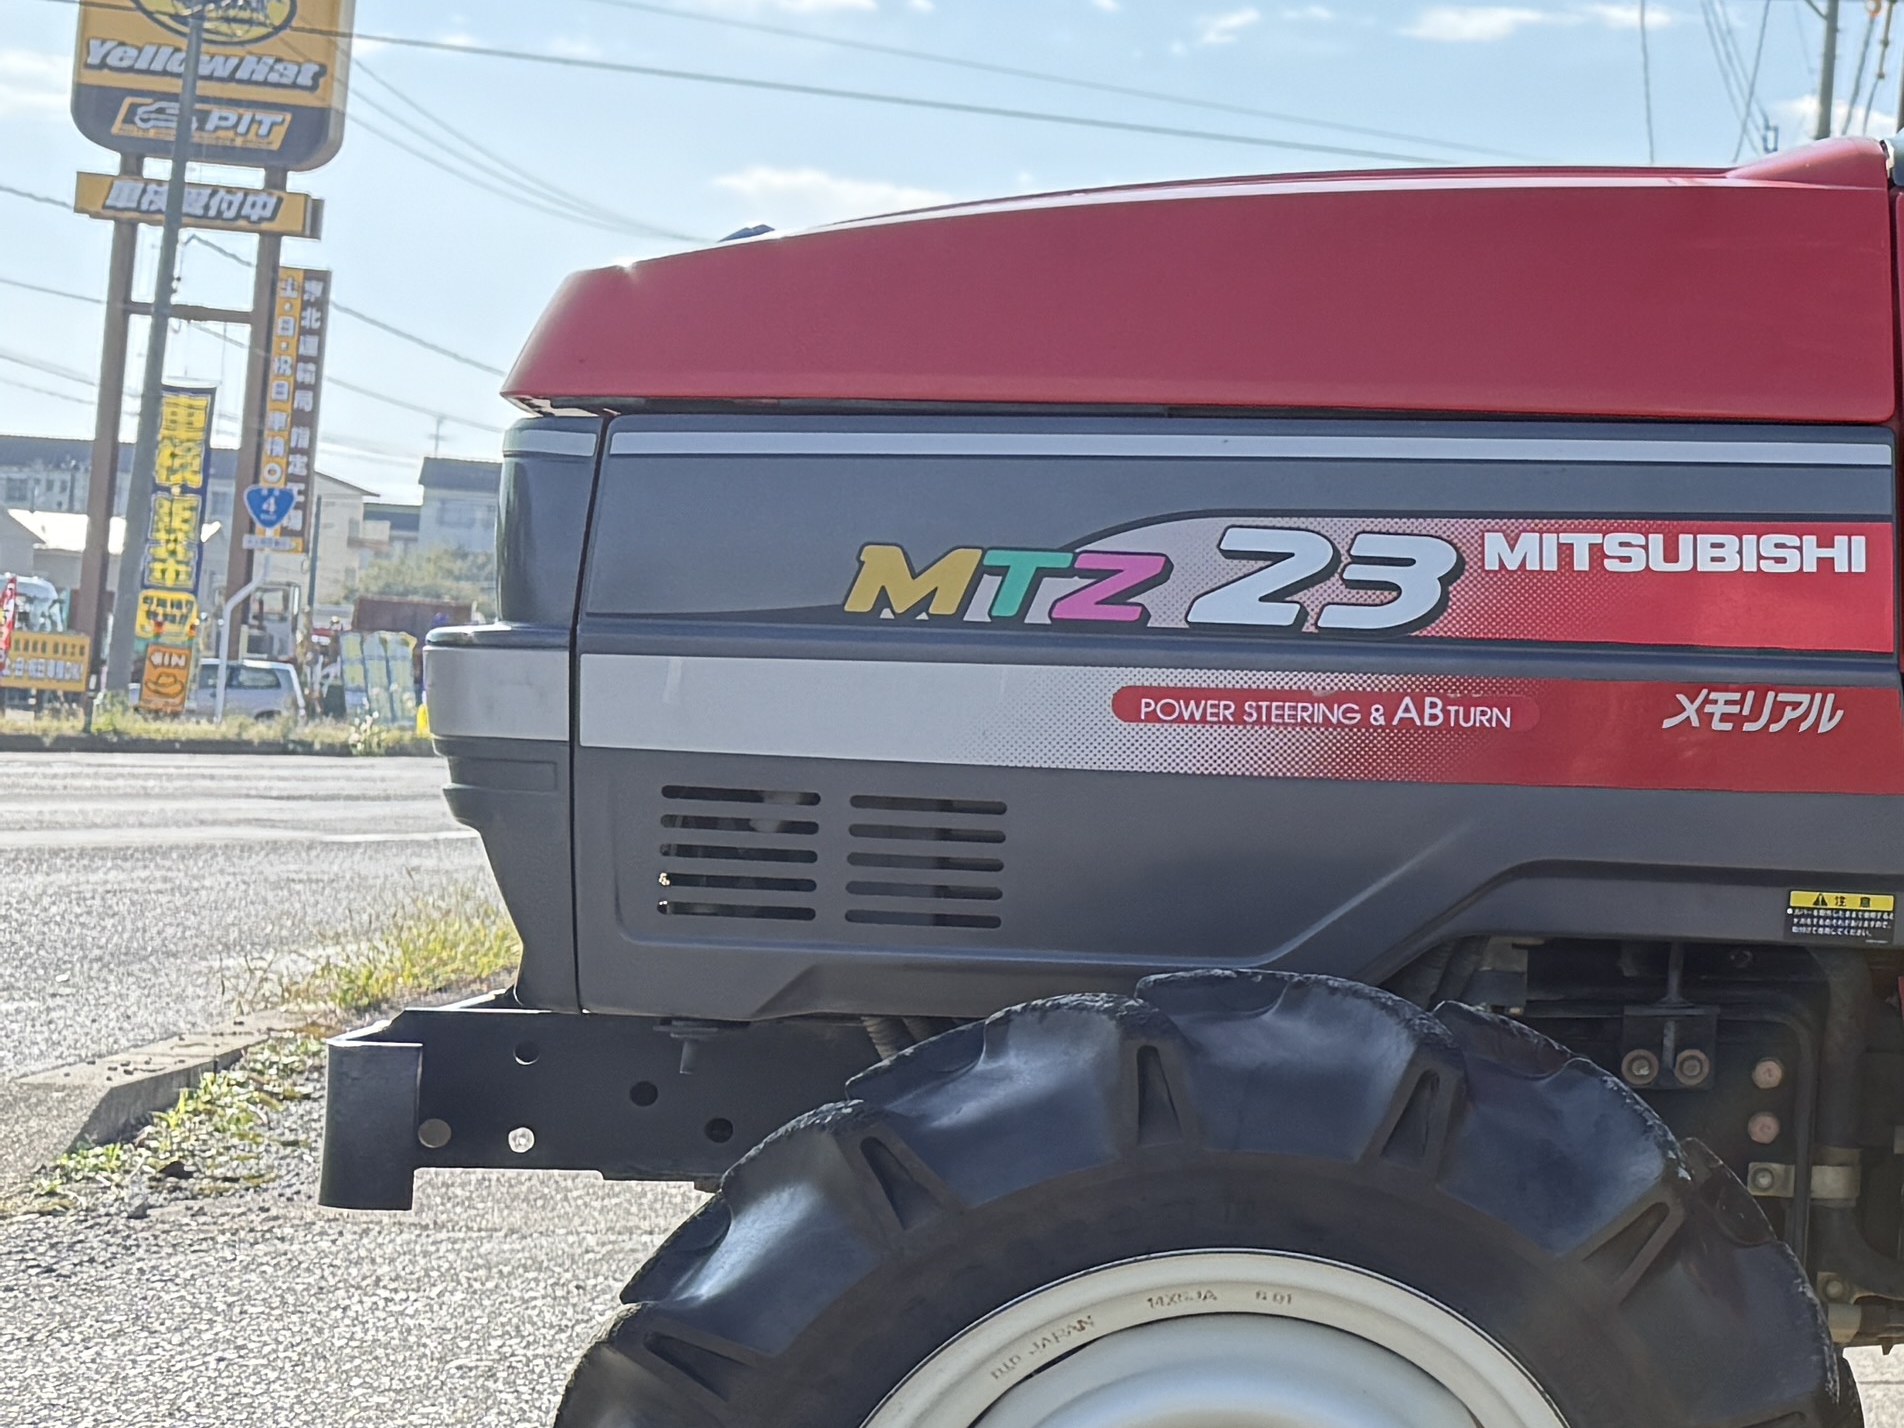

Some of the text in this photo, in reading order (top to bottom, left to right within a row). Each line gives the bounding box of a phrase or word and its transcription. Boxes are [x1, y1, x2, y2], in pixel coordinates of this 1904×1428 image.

[203, 108, 284, 138] PIT
[262, 496, 276, 515] 4
[1484, 532, 1866, 573] MITSUBISHI
[843, 525, 1460, 630] MTZ 23
[1140, 698, 1235, 722] POWER
[1243, 701, 1361, 726] STEERING
[1370, 705, 1385, 726] &
[1661, 688, 1845, 734] メモリアル
